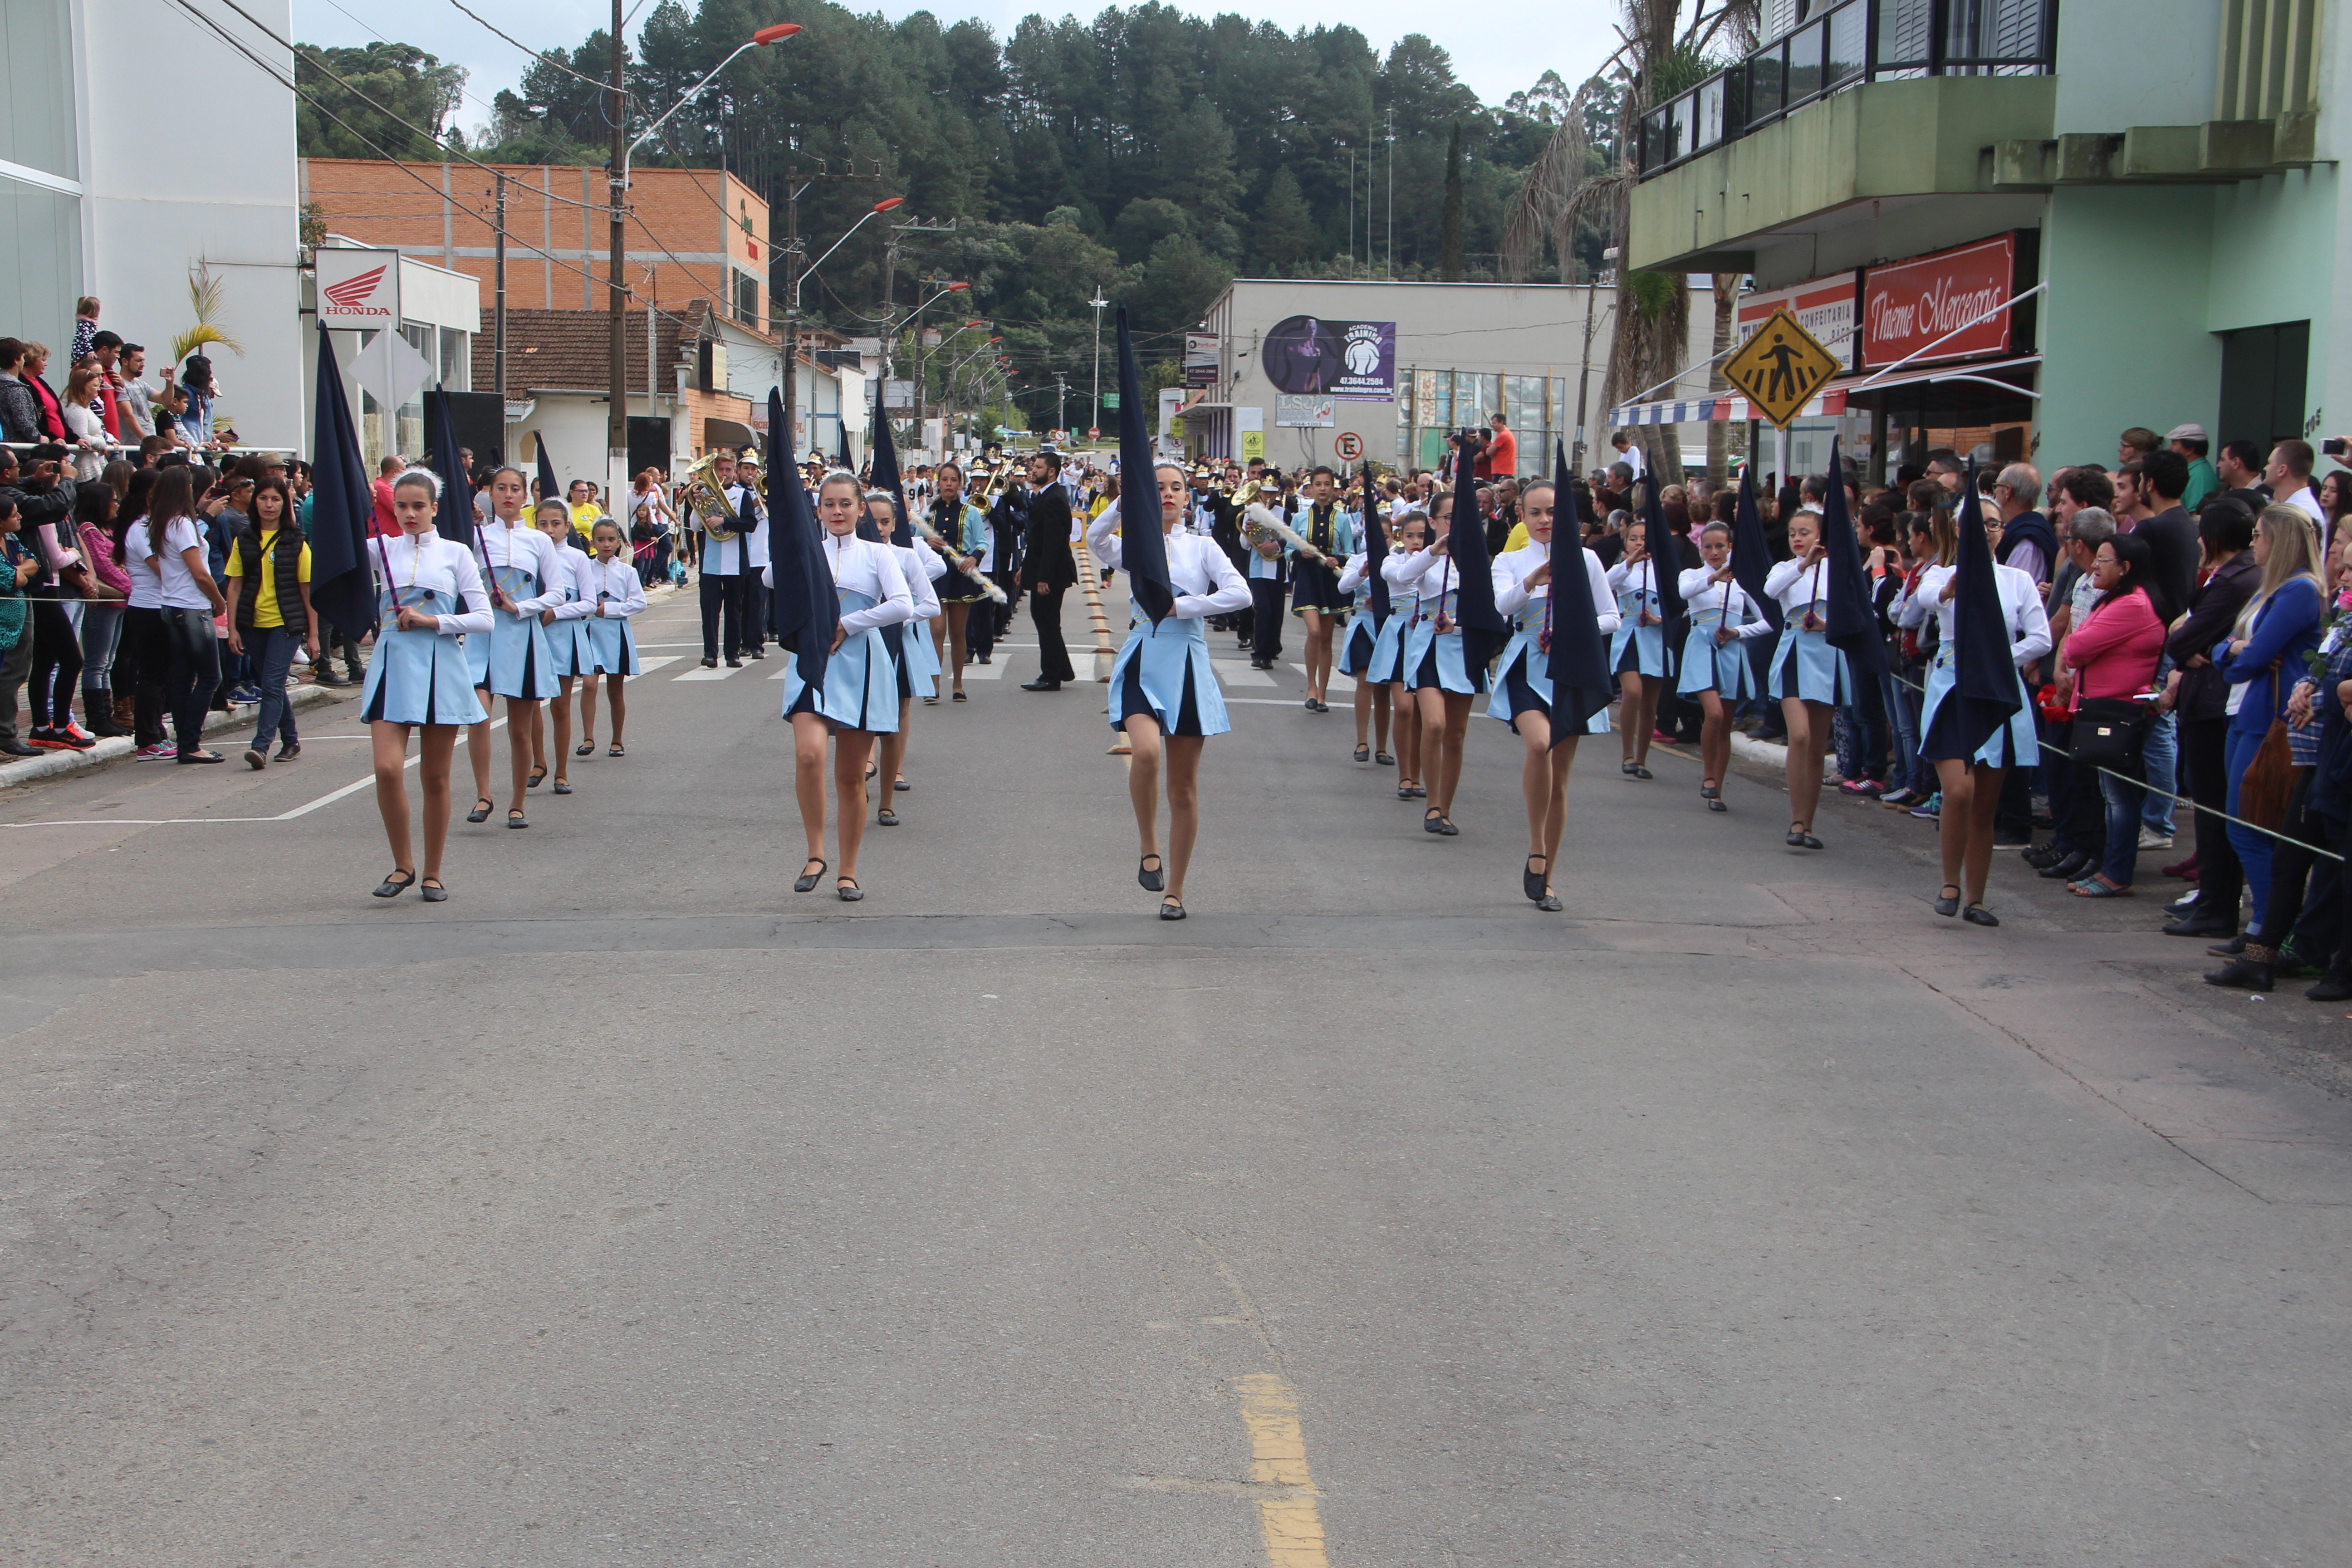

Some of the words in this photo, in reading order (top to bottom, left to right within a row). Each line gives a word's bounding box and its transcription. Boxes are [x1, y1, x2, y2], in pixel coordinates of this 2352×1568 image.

[325, 307, 391, 316] HONDA
[1800, 304, 1850, 328] CONFEITARIA
[1872, 290, 1915, 343] Thieme
[1919, 275, 2001, 334] Mercearia
[1343, 330, 1382, 345] TRAINING
[1339, 377, 1383, 385] 47.3644.2504
[1344, 438, 1355, 454] E
[909, 489, 916, 500] 9
